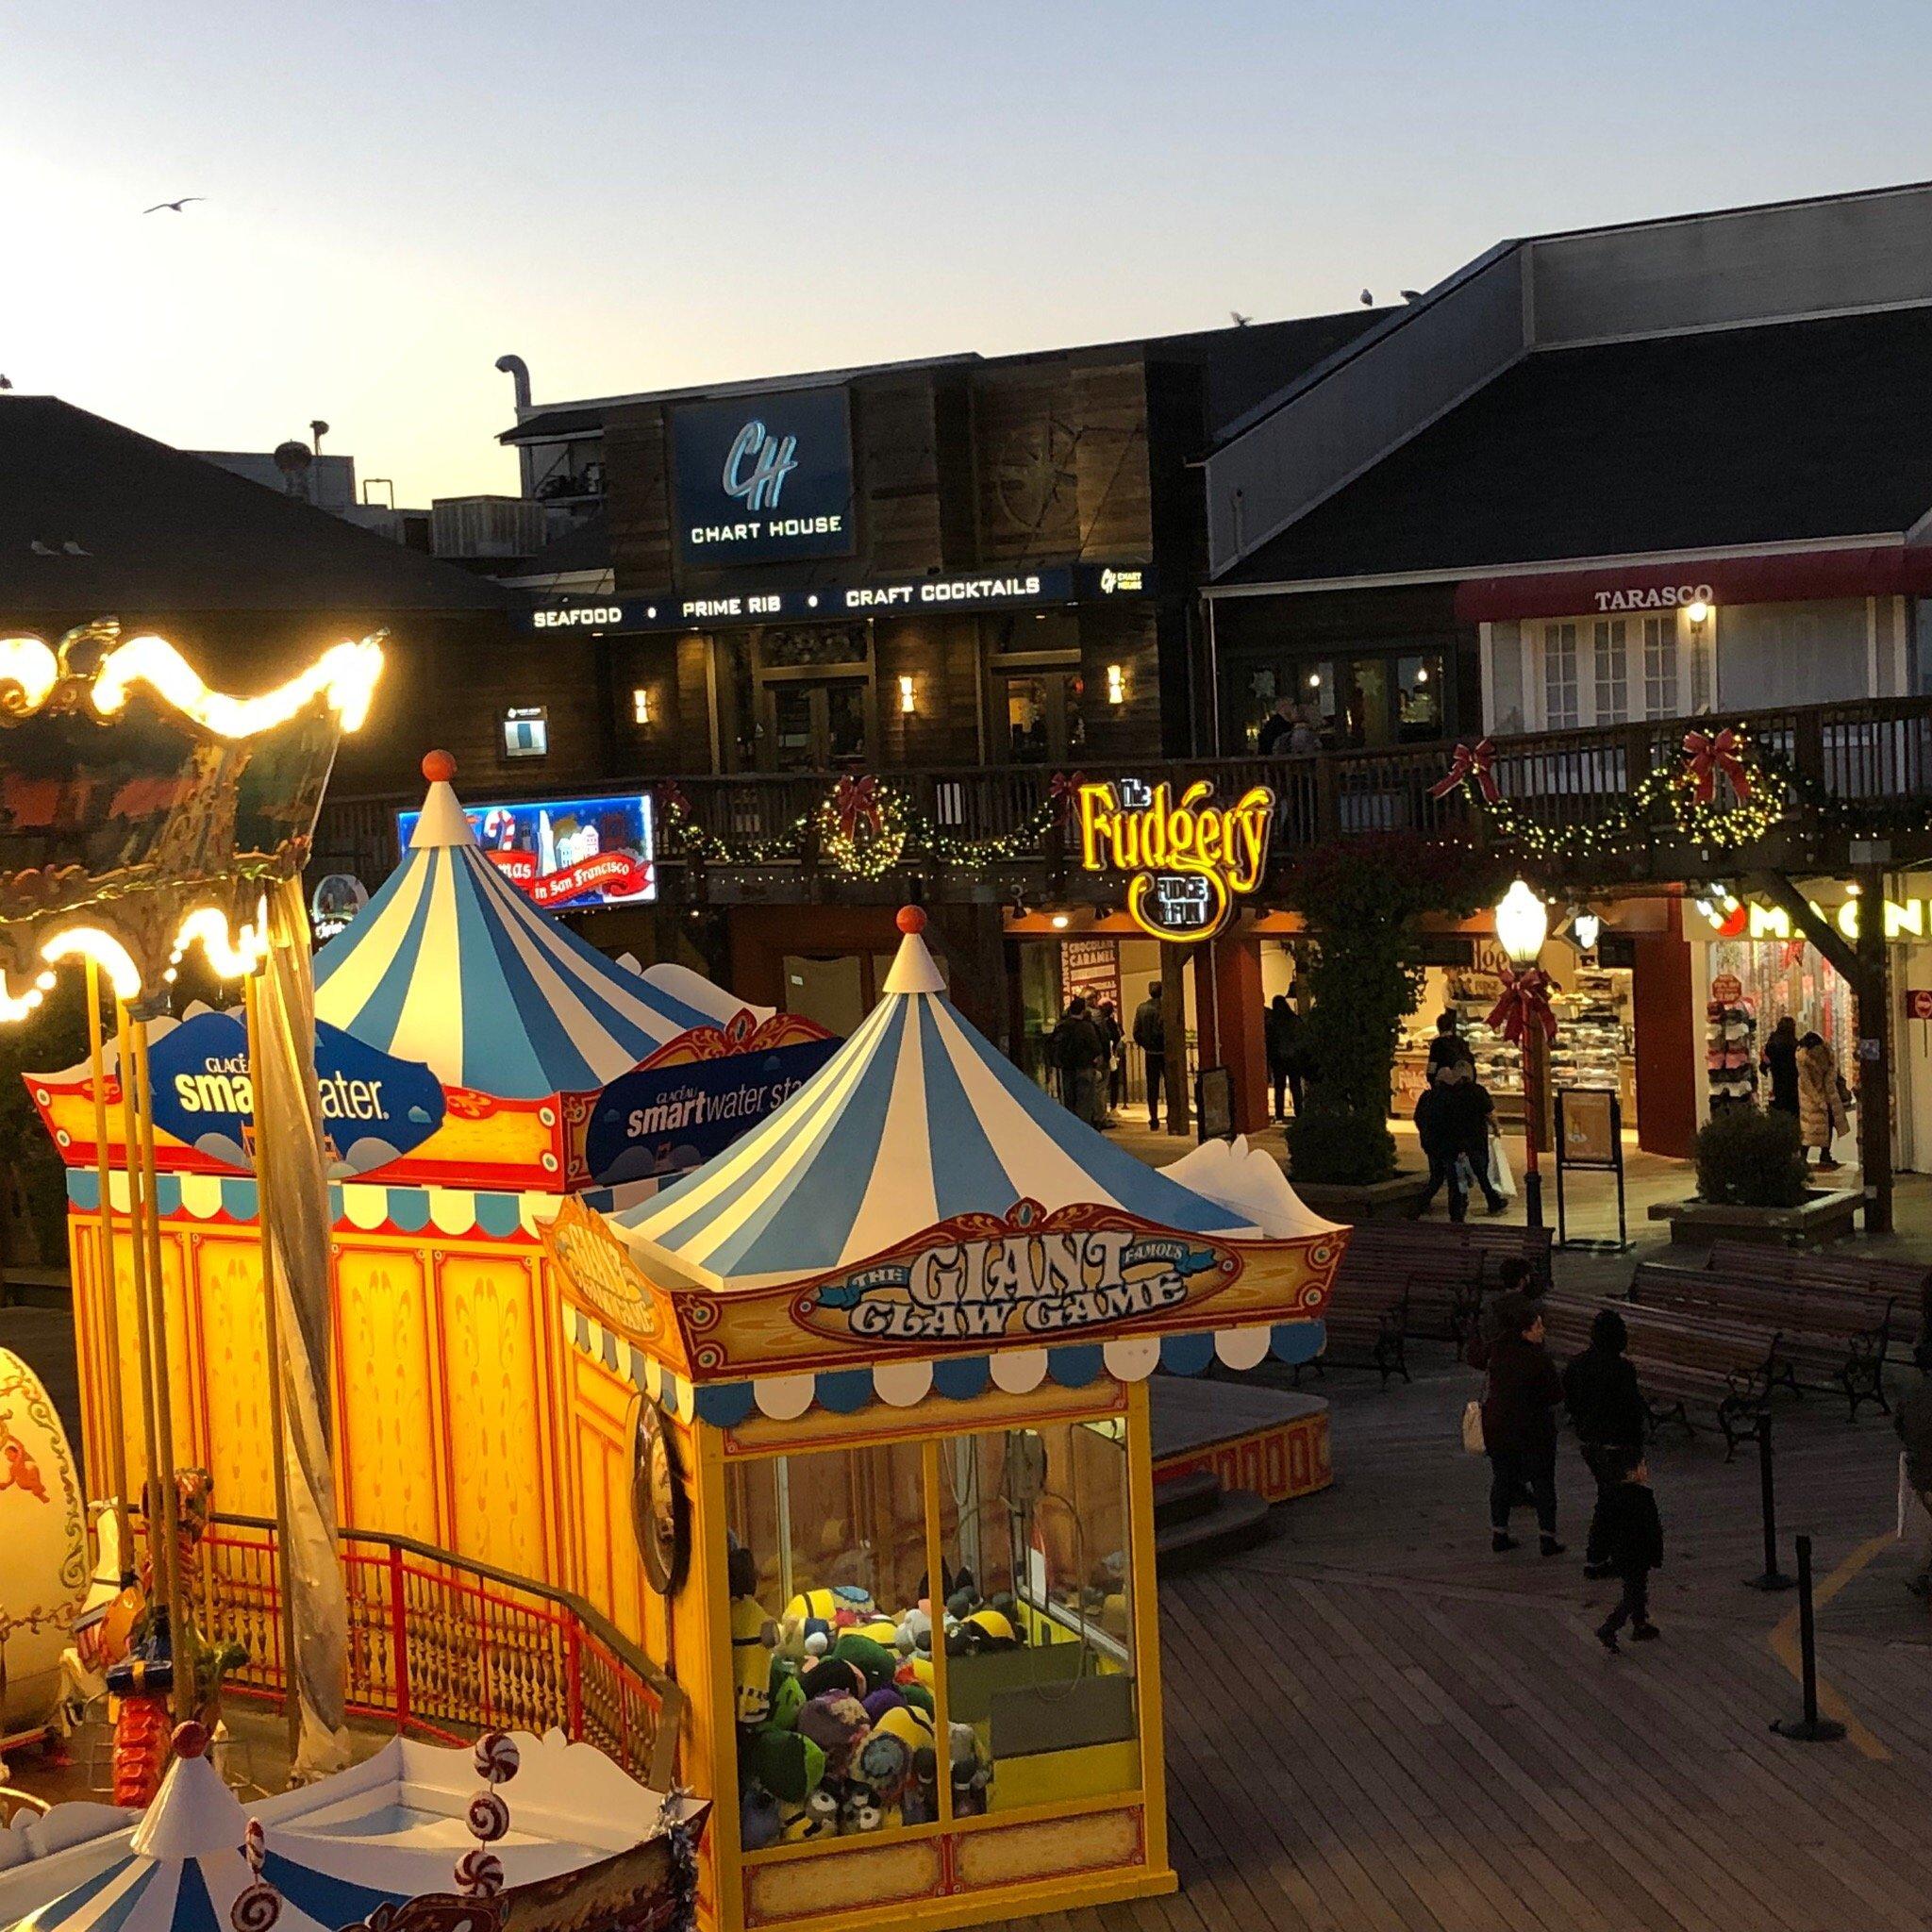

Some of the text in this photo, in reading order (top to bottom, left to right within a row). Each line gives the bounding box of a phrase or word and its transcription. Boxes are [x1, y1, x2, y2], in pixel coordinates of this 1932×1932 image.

[691, 515, 842, 544] CHART HOUSE
[845, 576, 1041, 608] CRAFT COCKTAILS
[1594, 584, 1714, 611] TARASCO
[533, 607, 623, 628] SEAFOOD
[682, 595, 781, 617] PRIME RIB
[535, 860, 630, 900] in San Francisco
[1069, 949, 1115, 968] CARAMEL
[1124, 1242, 1183, 1264] FAMOUS
[853, 1269, 904, 1288] THE
[910, 1232, 1134, 1305] GIANT
[850, 1274, 1187, 1337] CLAW GAME
